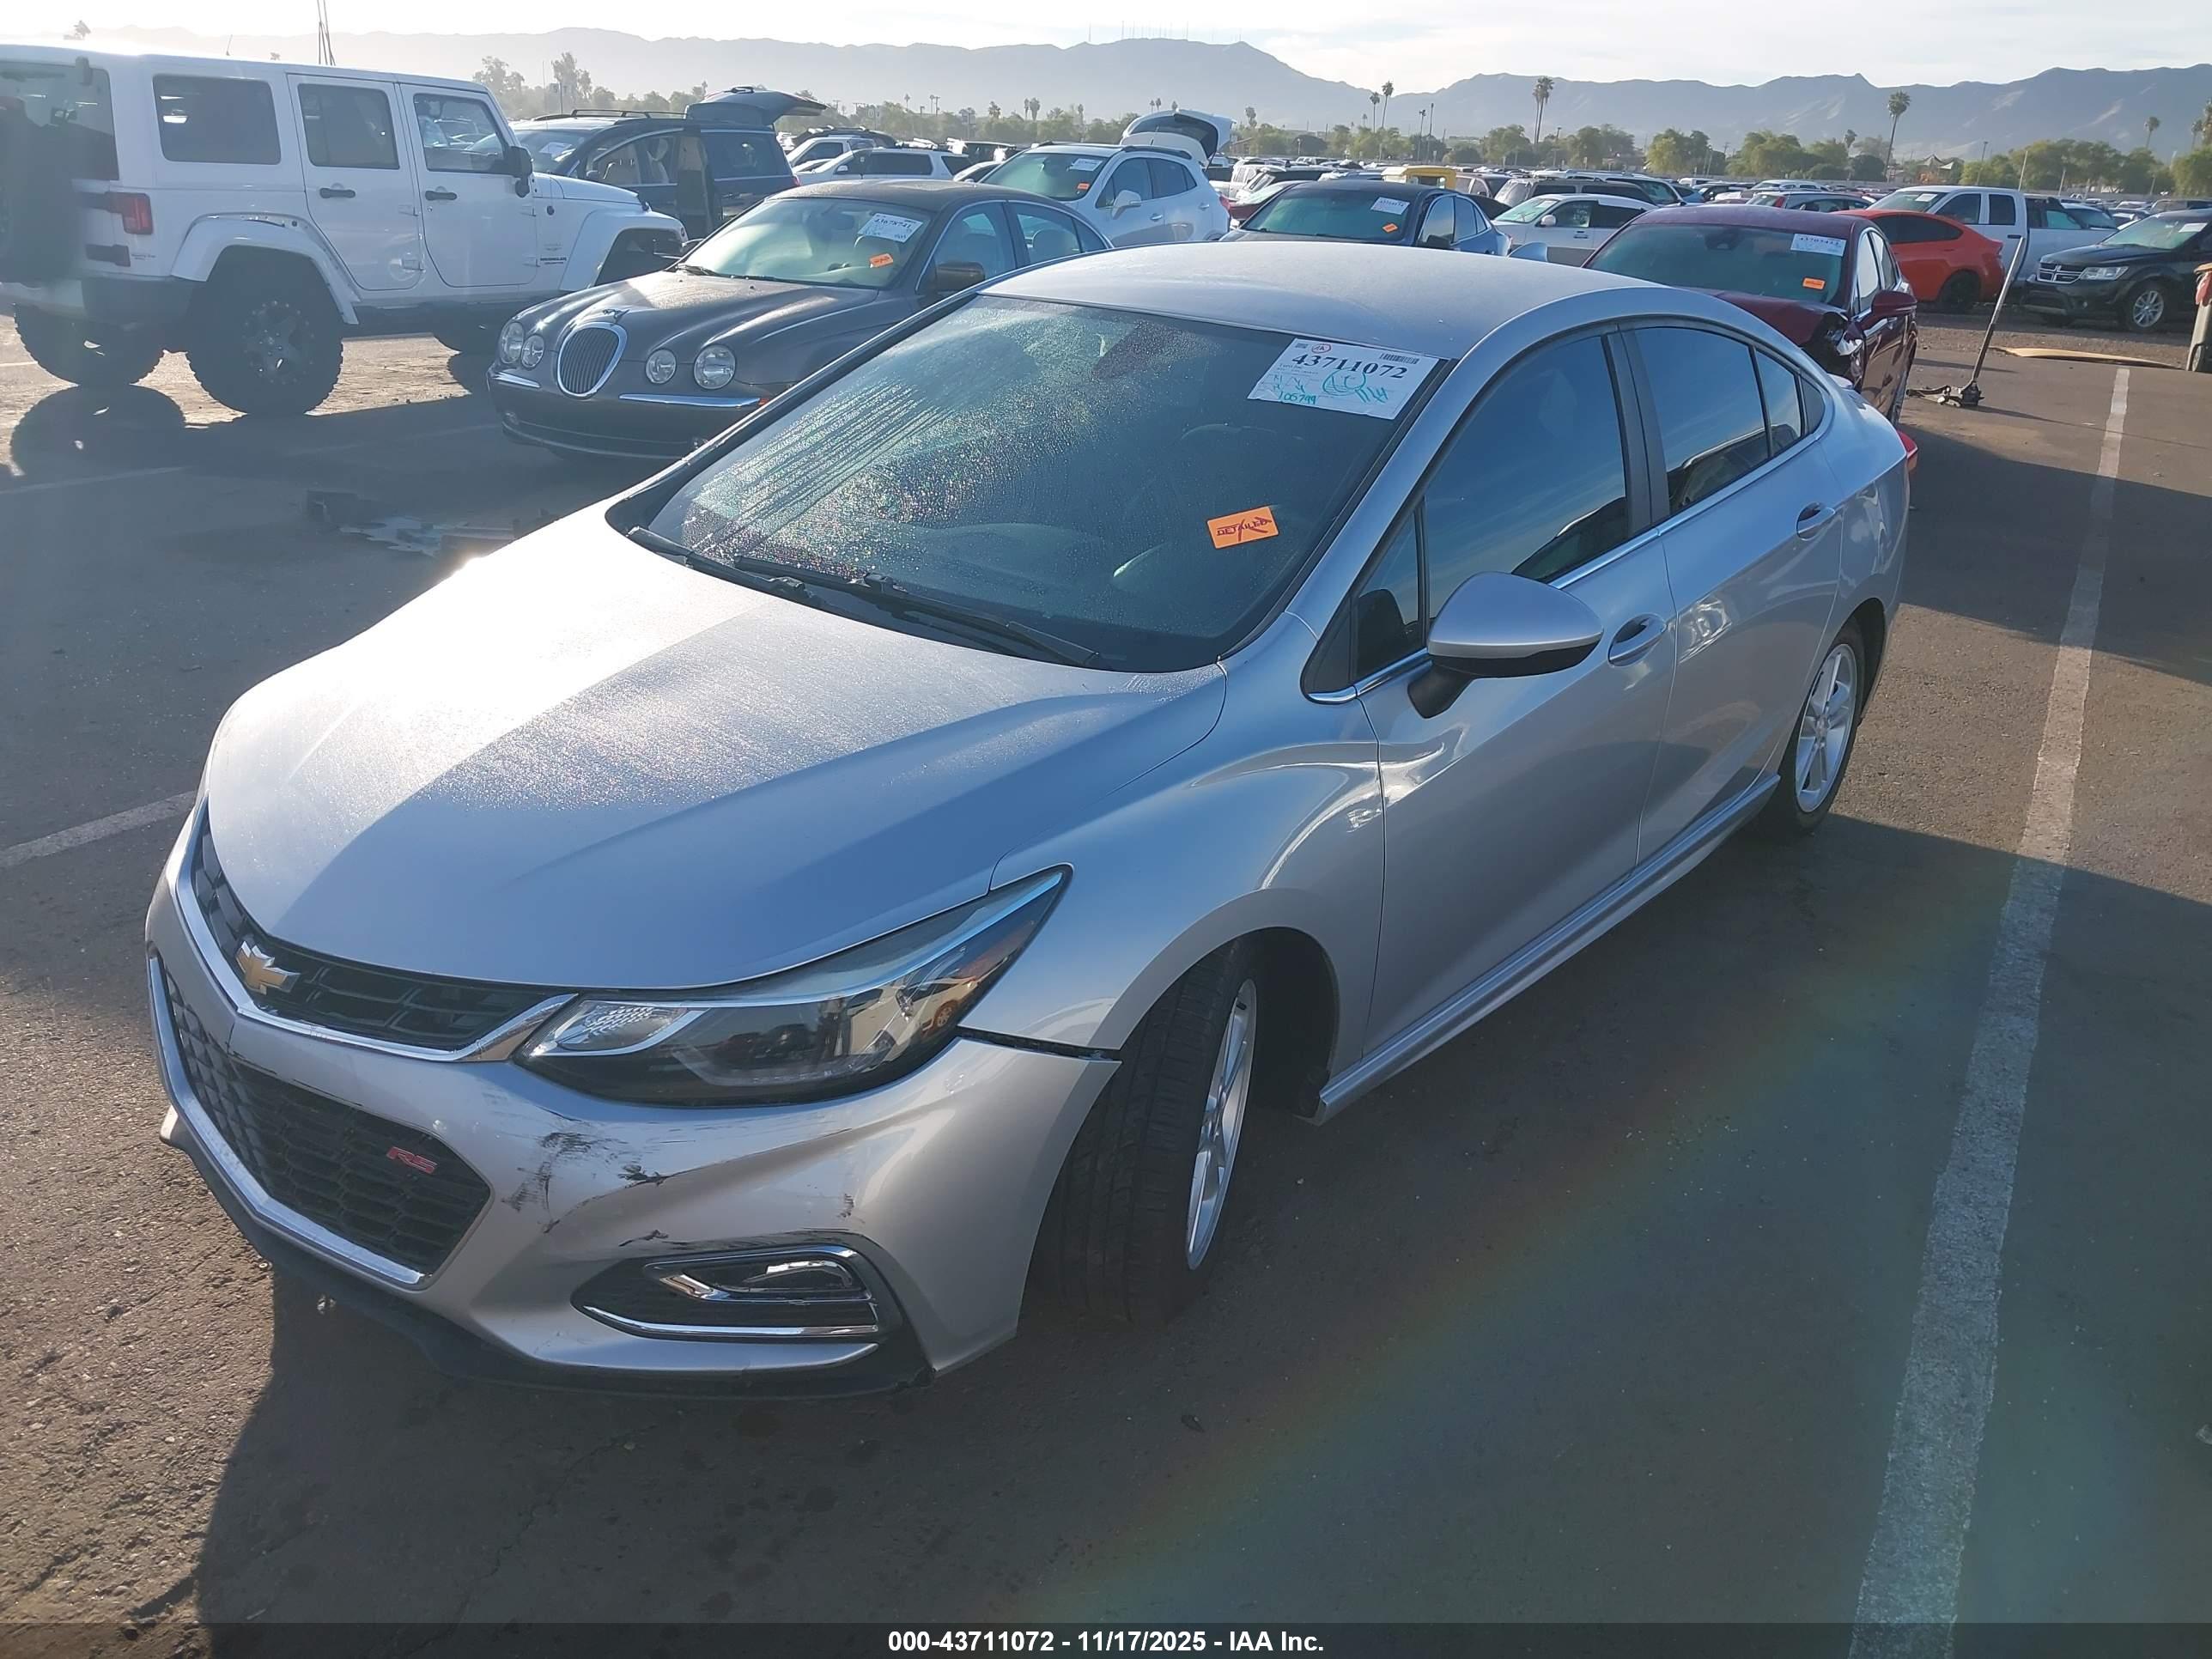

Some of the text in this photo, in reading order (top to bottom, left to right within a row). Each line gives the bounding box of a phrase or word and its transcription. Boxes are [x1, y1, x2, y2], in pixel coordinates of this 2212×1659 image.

[1291, 354, 1407, 379] 43711072
[1216, 518, 1268, 537] DETAILED
[386, 1146, 438, 1175] RS
